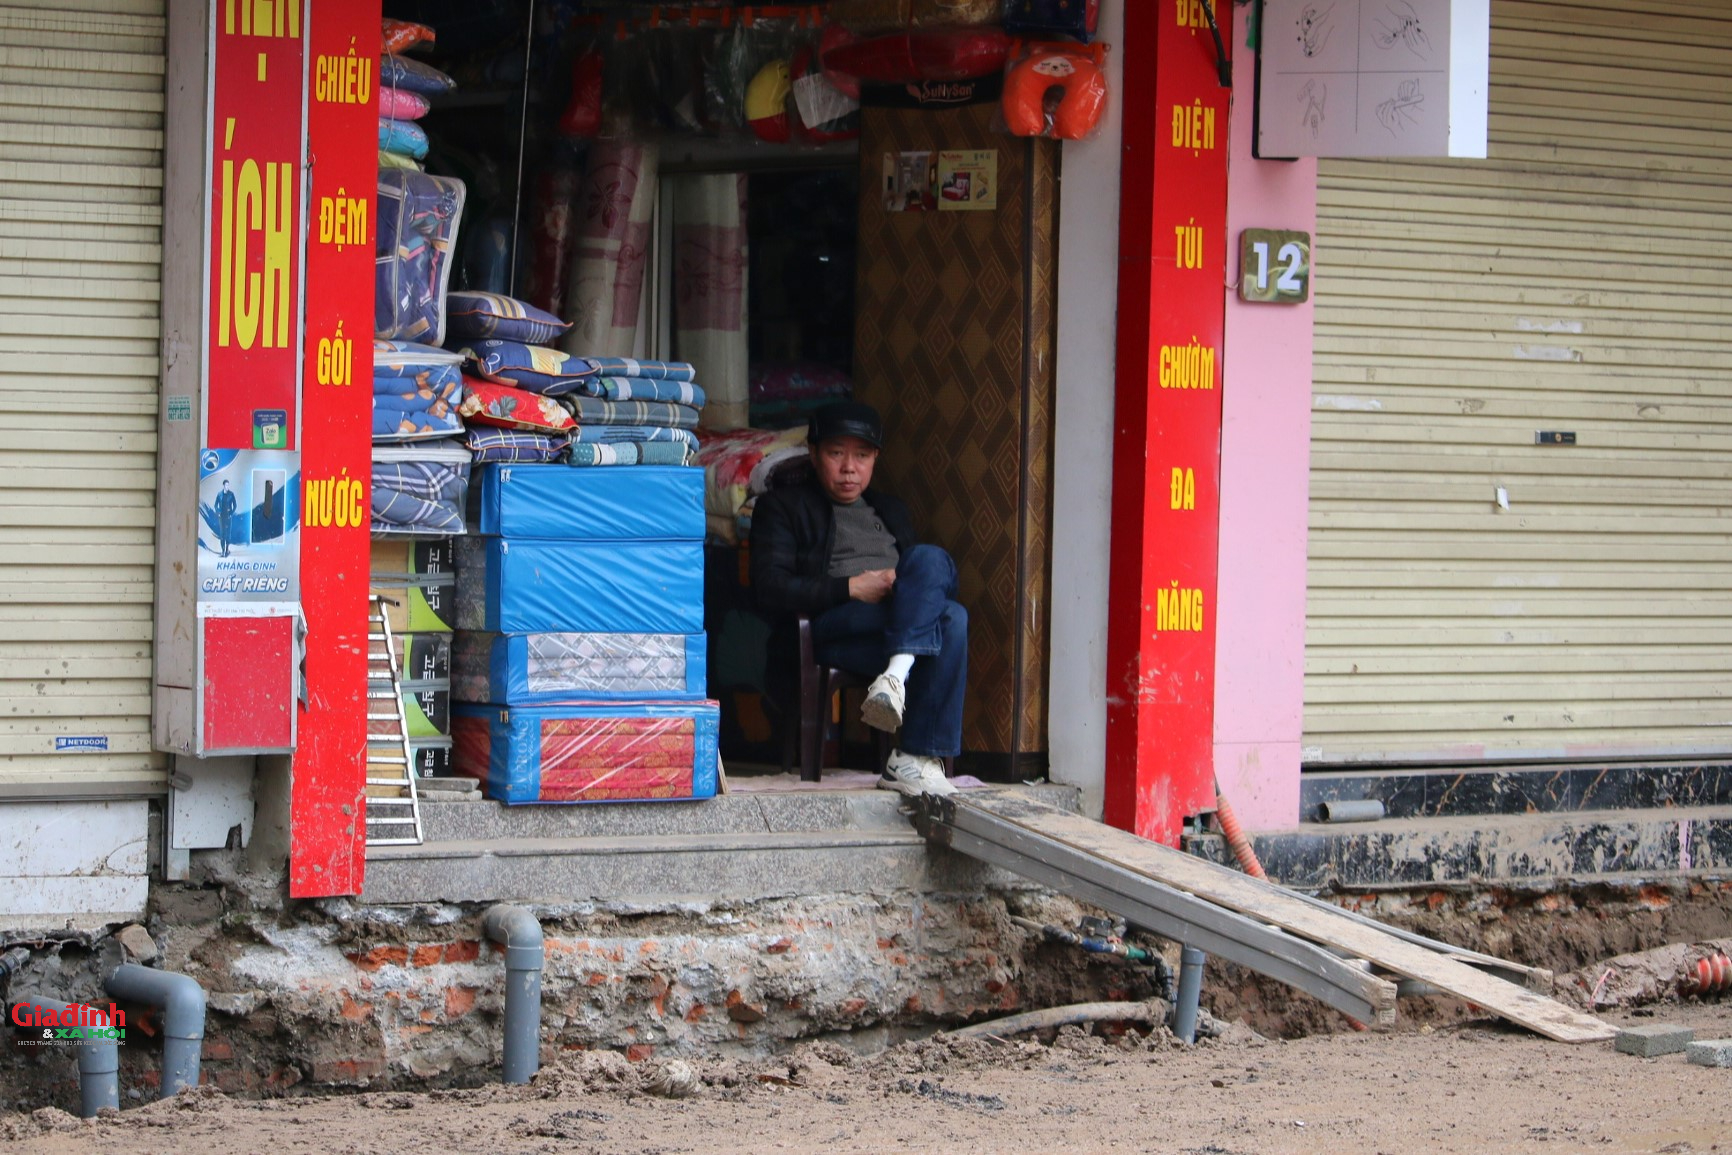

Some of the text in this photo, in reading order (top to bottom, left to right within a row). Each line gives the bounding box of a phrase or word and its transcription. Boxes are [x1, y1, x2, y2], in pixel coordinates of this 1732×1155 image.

[315, 36, 371, 104] CHIẾU
[1172, 98, 1215, 157] ĐIỆN
[218, 117, 292, 350] ÍCH
[319, 187, 367, 252] ĐỆM
[1175, 217, 1203, 270] TÚI
[1253, 241, 1301, 291] 12
[317, 320, 352, 386] GỐI
[1159, 335, 1215, 390] CHƯỜM
[305, 467, 363, 528] NƯỚC
[1170, 467, 1195, 510] ĐA
[202, 574, 288, 593] CHẤT RIÊNG
[1156, 579, 1203, 631] NĂNG
